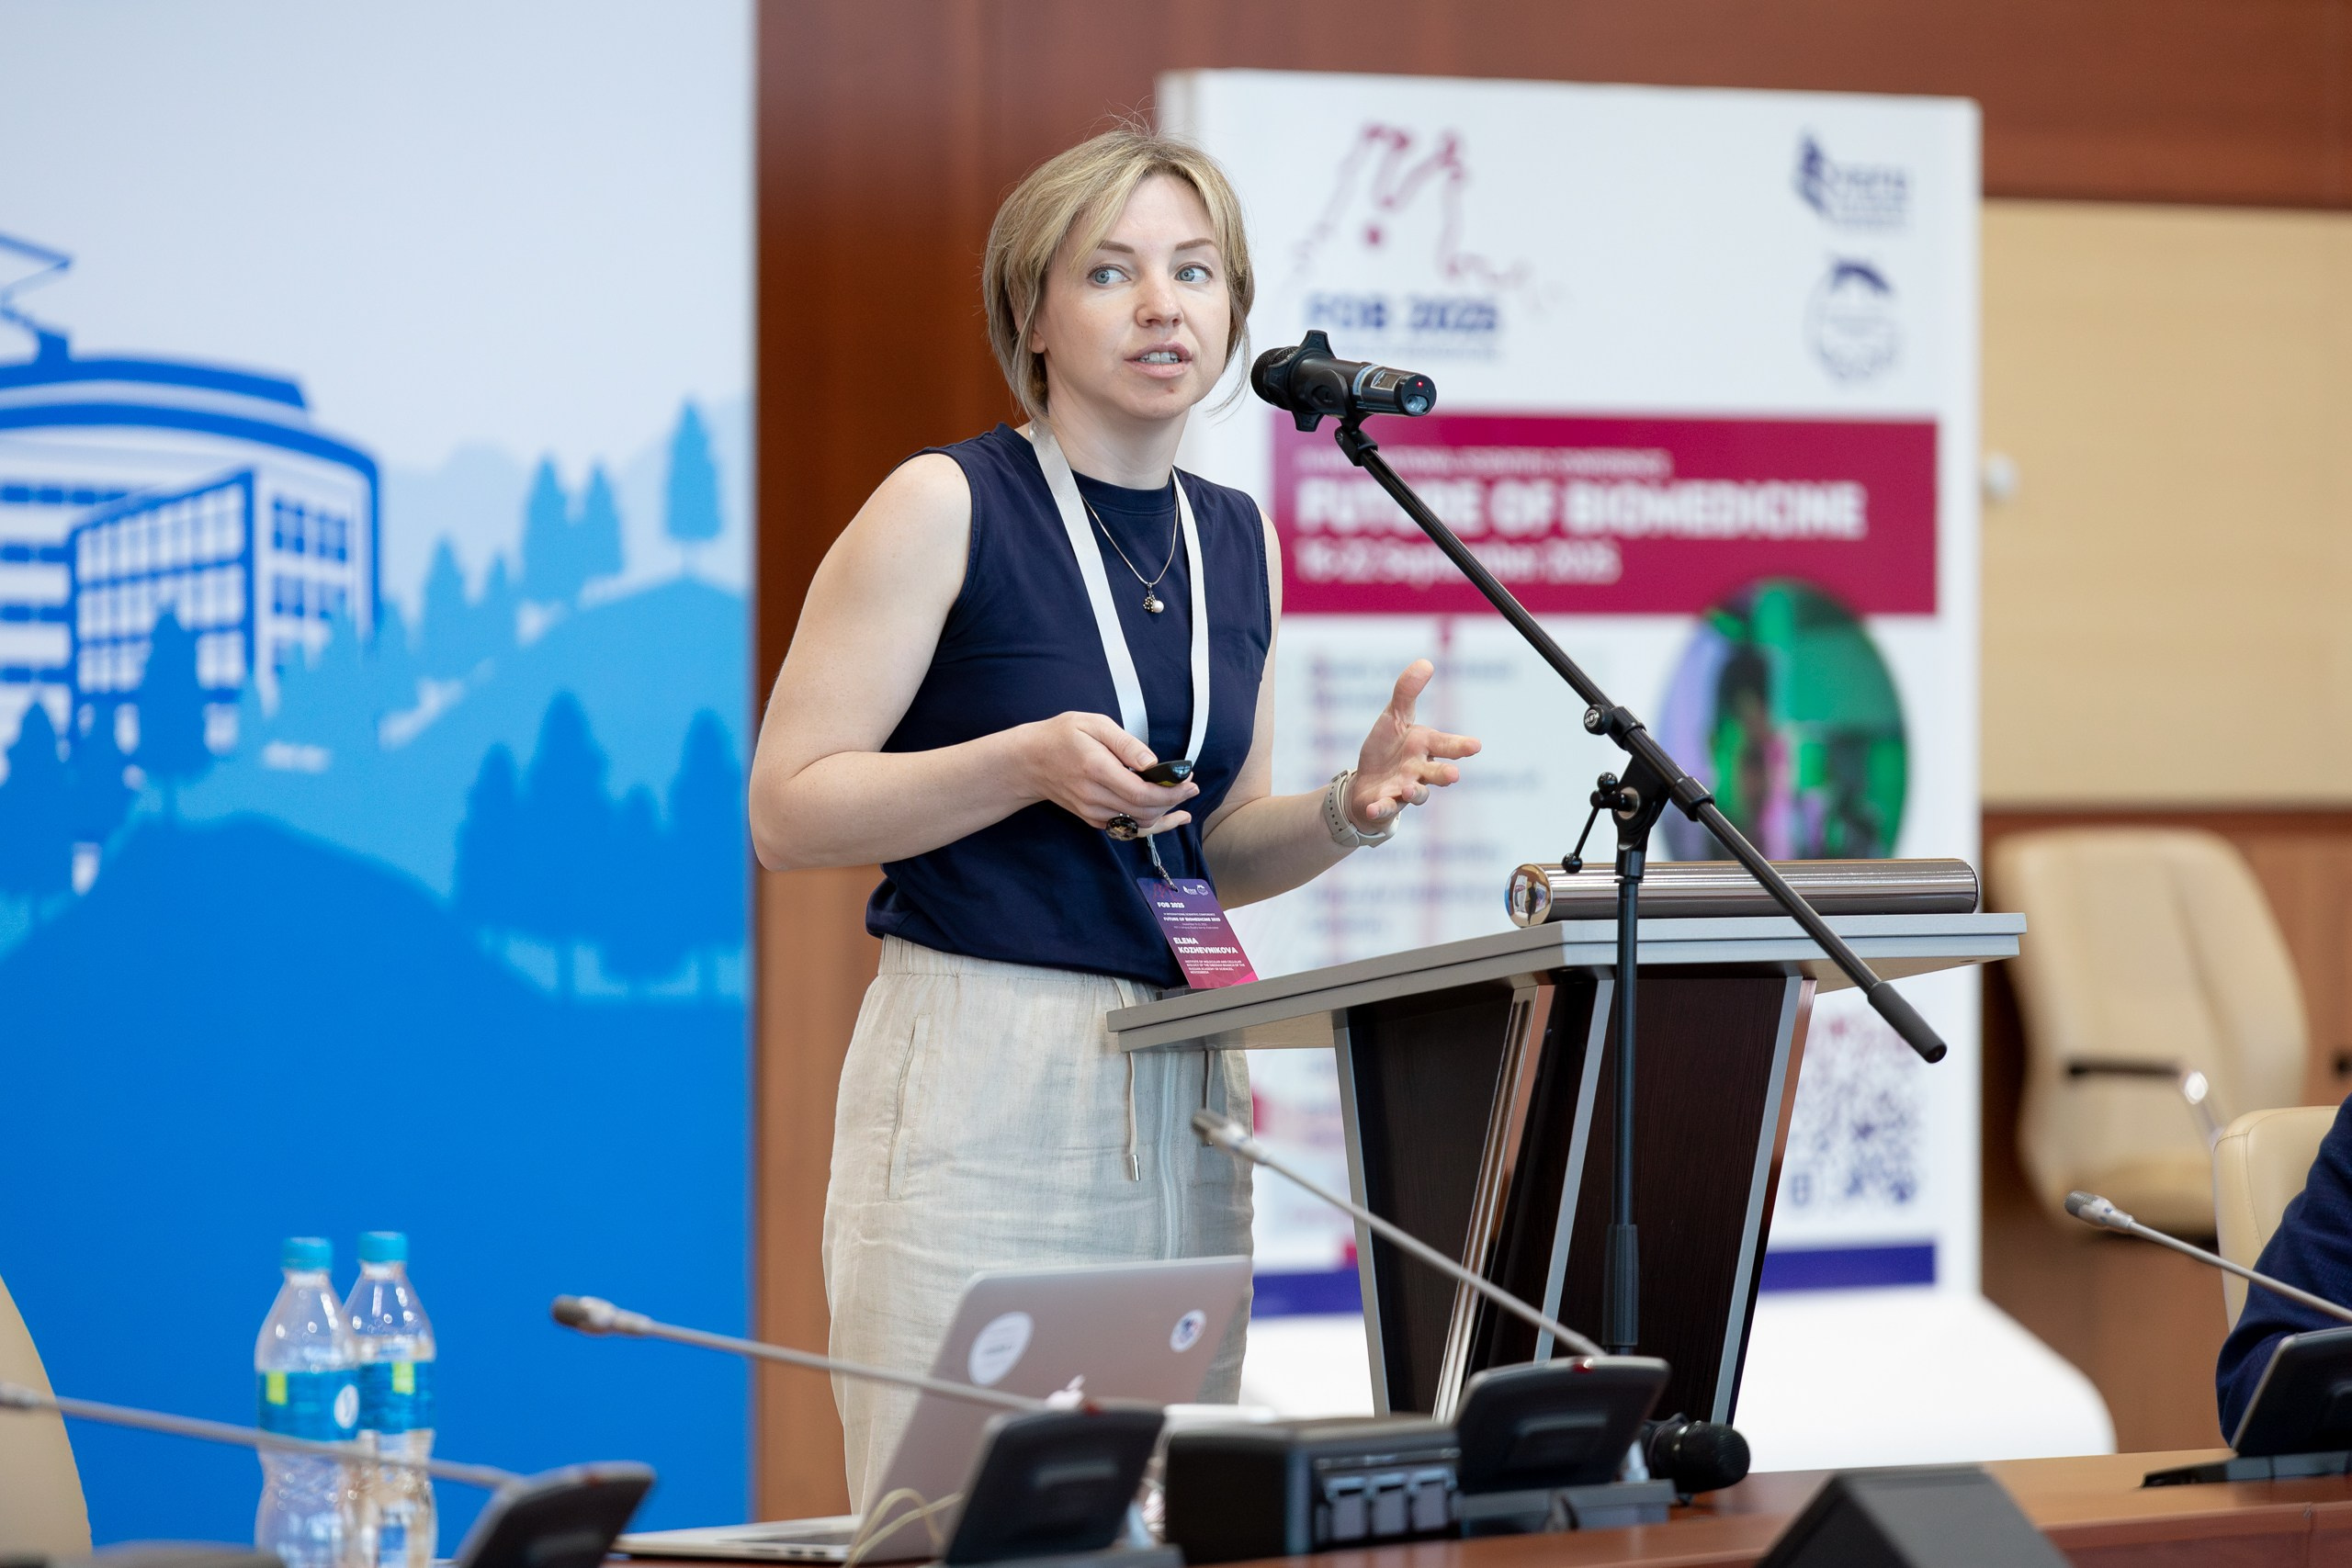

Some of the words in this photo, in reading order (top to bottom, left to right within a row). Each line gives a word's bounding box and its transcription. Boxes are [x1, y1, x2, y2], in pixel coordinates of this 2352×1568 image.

[1306, 293, 1389, 329] FOB
[1295, 477, 1485, 536] FUTURE
[1489, 479, 1556, 537] OF
[1562, 479, 1869, 540] BIOMEDICINE
